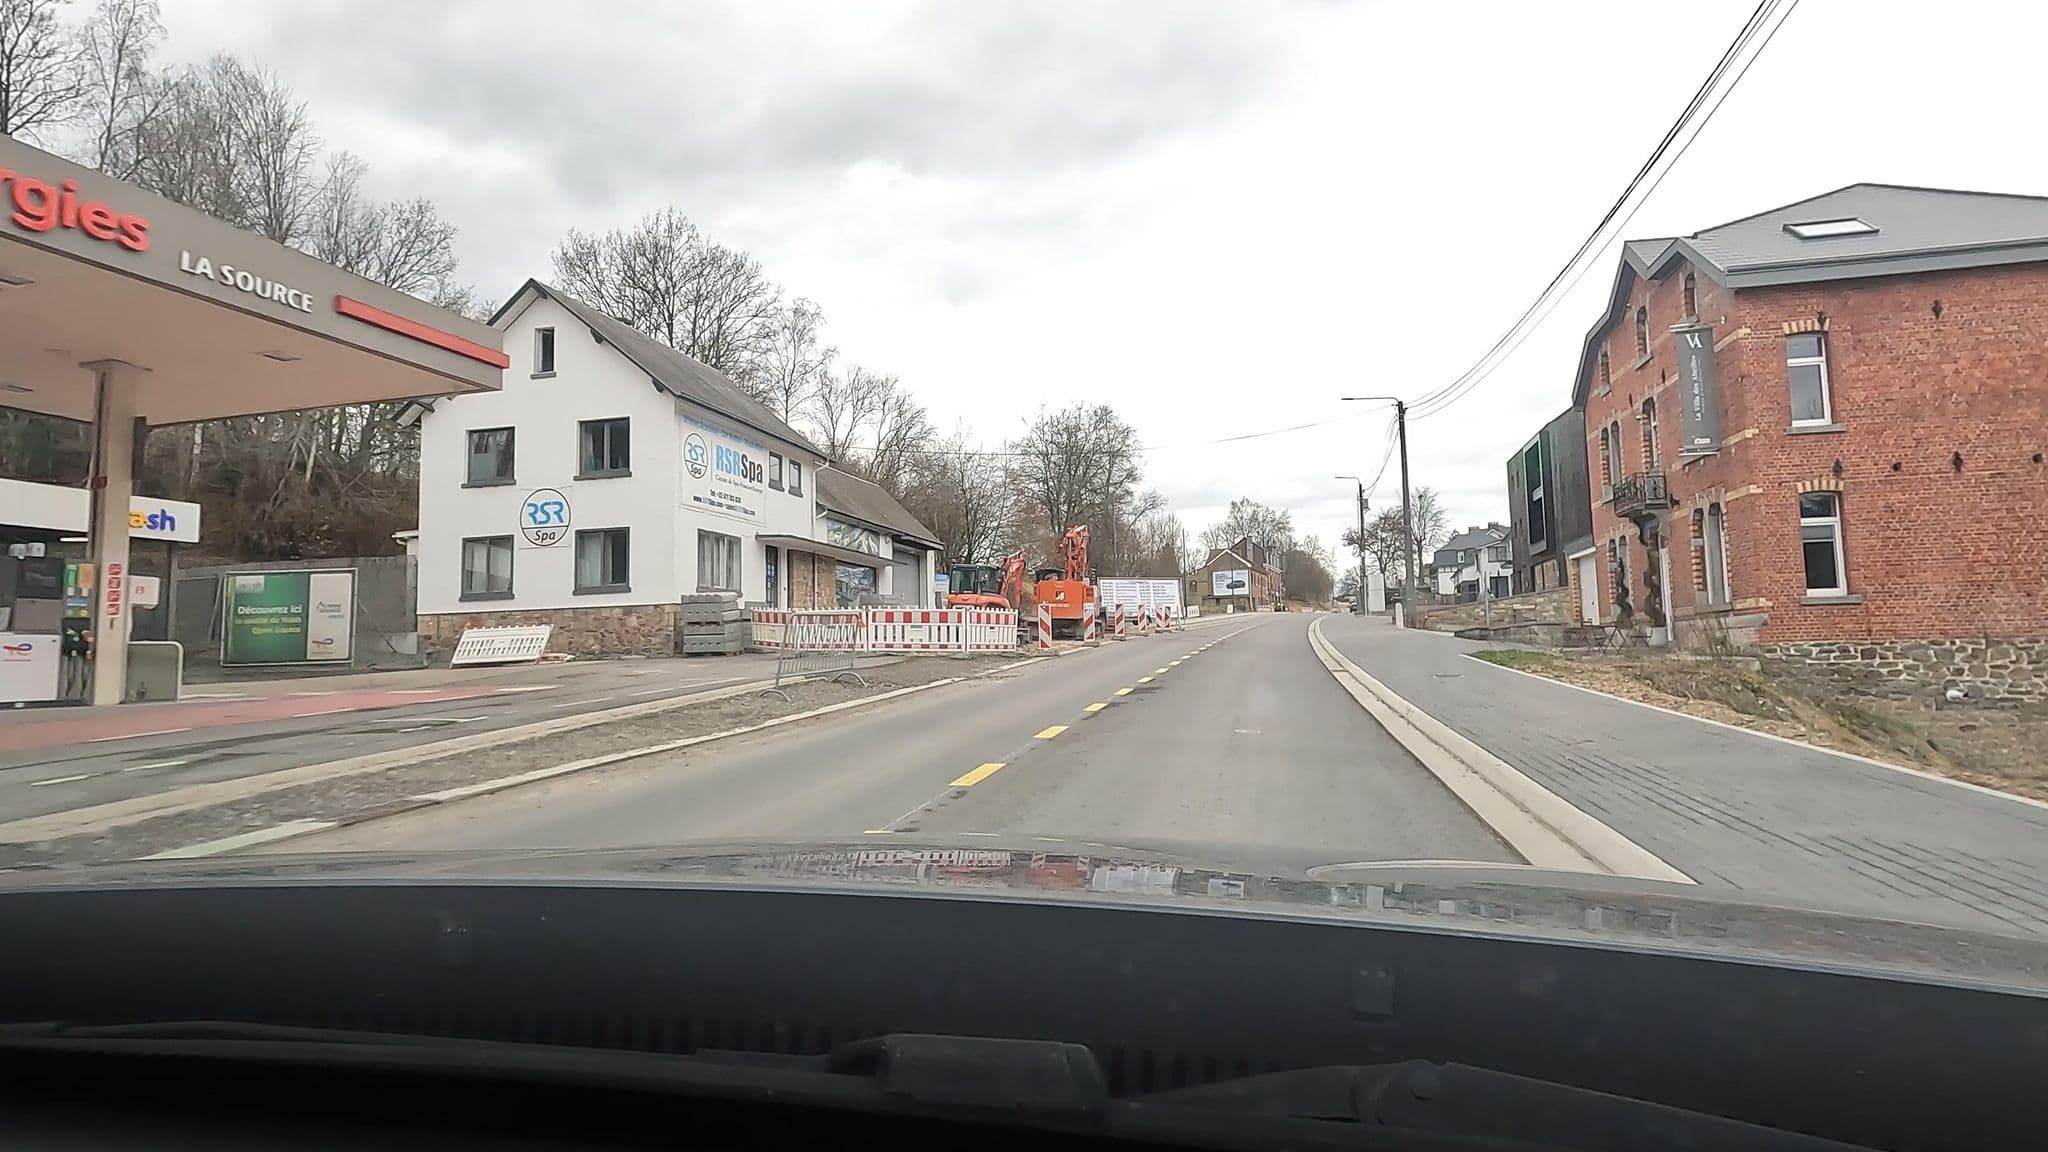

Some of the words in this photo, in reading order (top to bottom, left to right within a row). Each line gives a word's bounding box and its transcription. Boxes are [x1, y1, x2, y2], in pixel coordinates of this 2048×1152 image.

[180, 250, 214, 279] LA
[220, 264, 313, 313] SOURCE
[687, 442, 705, 463] RSR
[691, 464, 702, 477] Spa
[716, 445, 763, 483] RSRSpa
[129, 509, 176, 531] ash
[527, 501, 564, 525] RSR
[534, 530, 556, 543] Spa
[237, 605, 288, 614] Découvrez
[290, 604, 302, 613] ici
